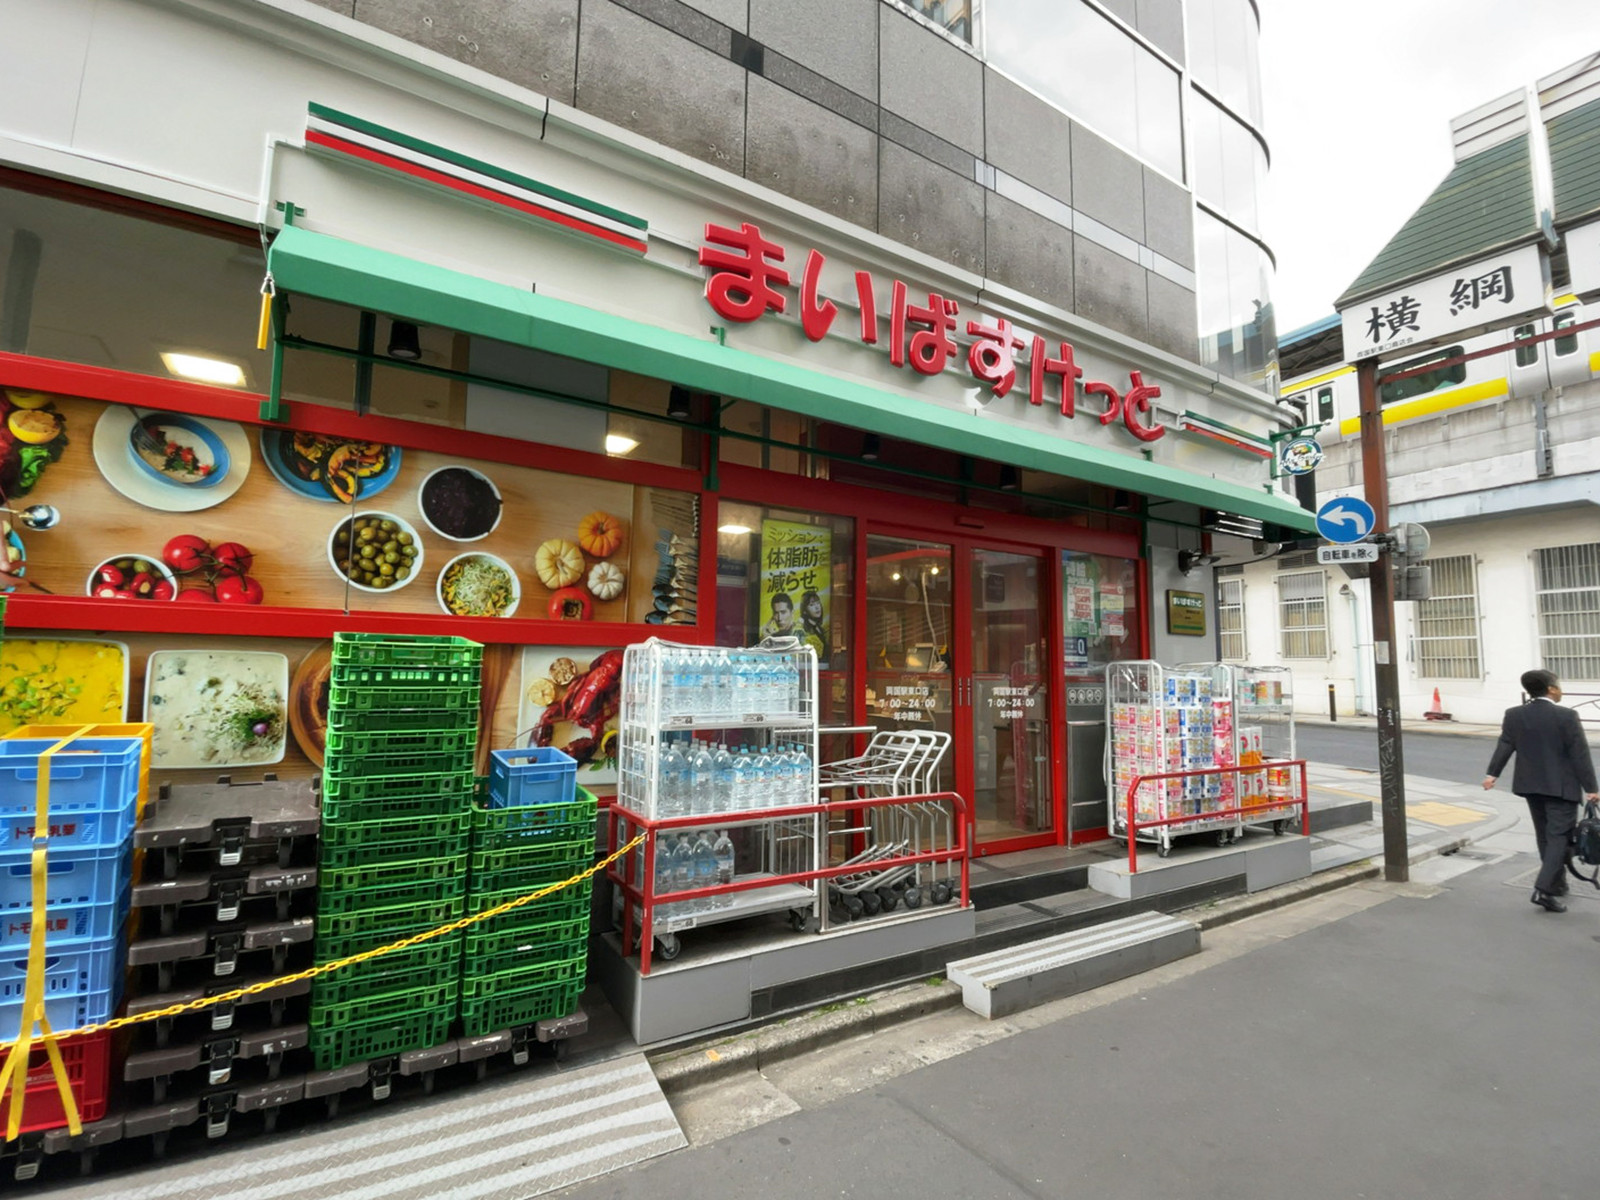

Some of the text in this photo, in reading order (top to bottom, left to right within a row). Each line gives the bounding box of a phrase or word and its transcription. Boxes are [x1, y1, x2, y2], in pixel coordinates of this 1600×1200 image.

[1364, 266, 1515, 344] 横綱
[699, 222, 1166, 442] まいばすけっと
[1322, 548, 1373, 561] 自転車を除く
[15, 823, 76, 840] トモ乳業
